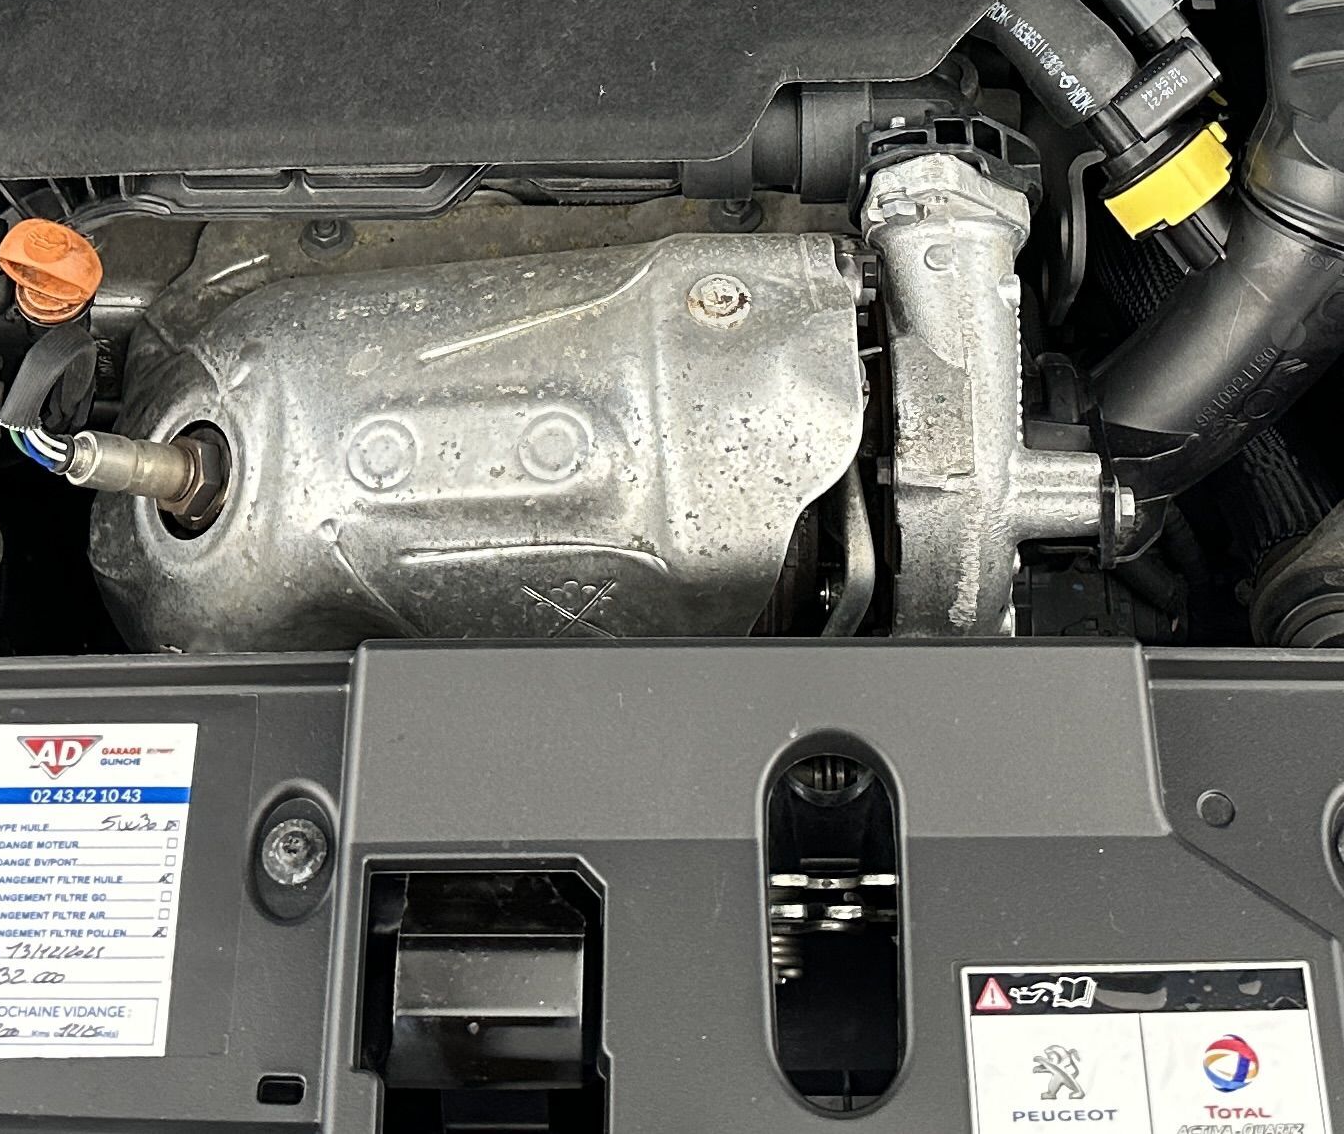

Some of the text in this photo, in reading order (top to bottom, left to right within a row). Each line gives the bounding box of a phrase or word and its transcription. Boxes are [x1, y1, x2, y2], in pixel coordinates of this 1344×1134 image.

[30, 740, 84, 768] AD
[101, 747, 142, 755] GARAGE
[30, 788, 142, 803] 02 43 42 10 43
[20, 824, 49, 832] HUILE
[36, 841, 79, 849] MOTEUR
[57, 876, 90, 884] FILTRE
[52, 911, 85, 919] FILTRE
[87, 911, 105, 919] AIR
[49, 929, 84, 937] FILTRE
[86, 929, 127, 937] POLLEN
[64, 1005, 125, 1018] VIDANGE
[1012, 1109, 1118, 1122] PEUGEOT
